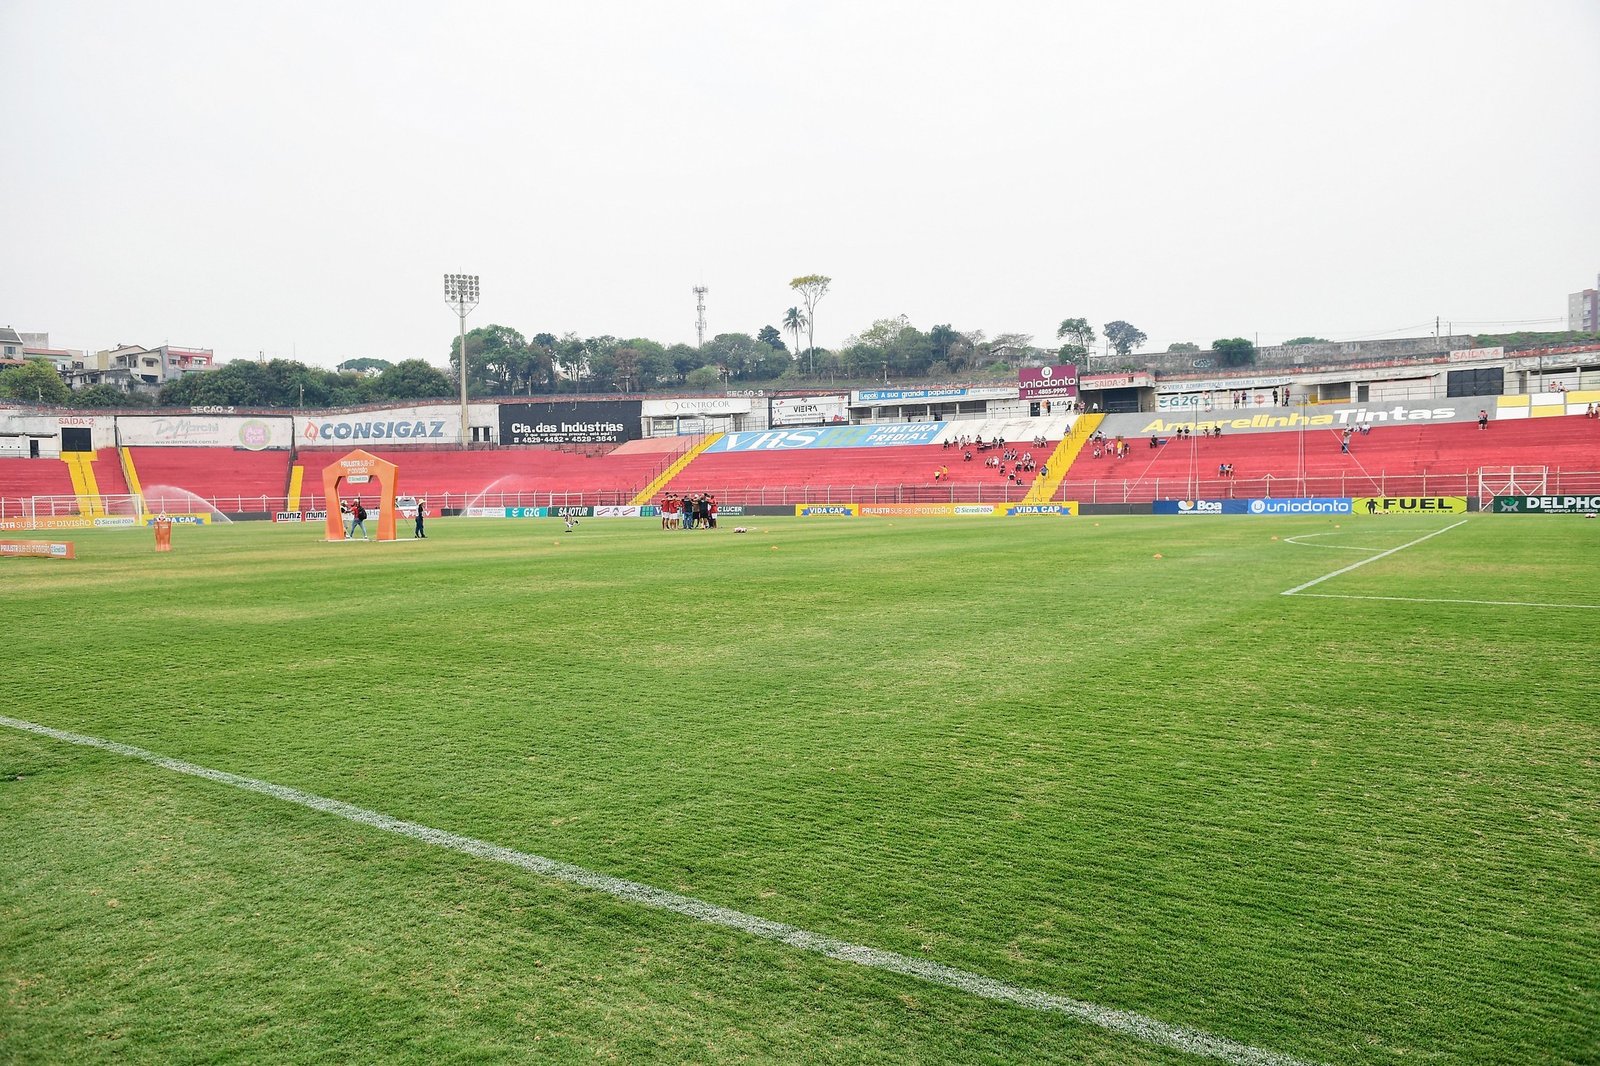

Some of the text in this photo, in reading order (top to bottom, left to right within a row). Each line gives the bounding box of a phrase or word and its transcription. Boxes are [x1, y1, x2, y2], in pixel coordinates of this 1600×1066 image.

[1019, 377, 1076, 389] uniodonto
[902, 390, 924, 398] grande
[680, 400, 730, 409] CENTROCOR
[1141, 406, 1456, 433] Amarelinha Tintas
[320, 421, 446, 440] CONSIGAZ
[562, 422, 624, 432] Indústrias
[874, 424, 939, 434] PINTURA
[727, 430, 825, 450] VRS
[865, 433, 928, 442] PREDIAL
[1197, 500, 1222, 510] Boa
[1267, 500, 1349, 512] uniodonto
[1384, 498, 1452, 509] FUEL
[523, 508, 540, 516] G2G
